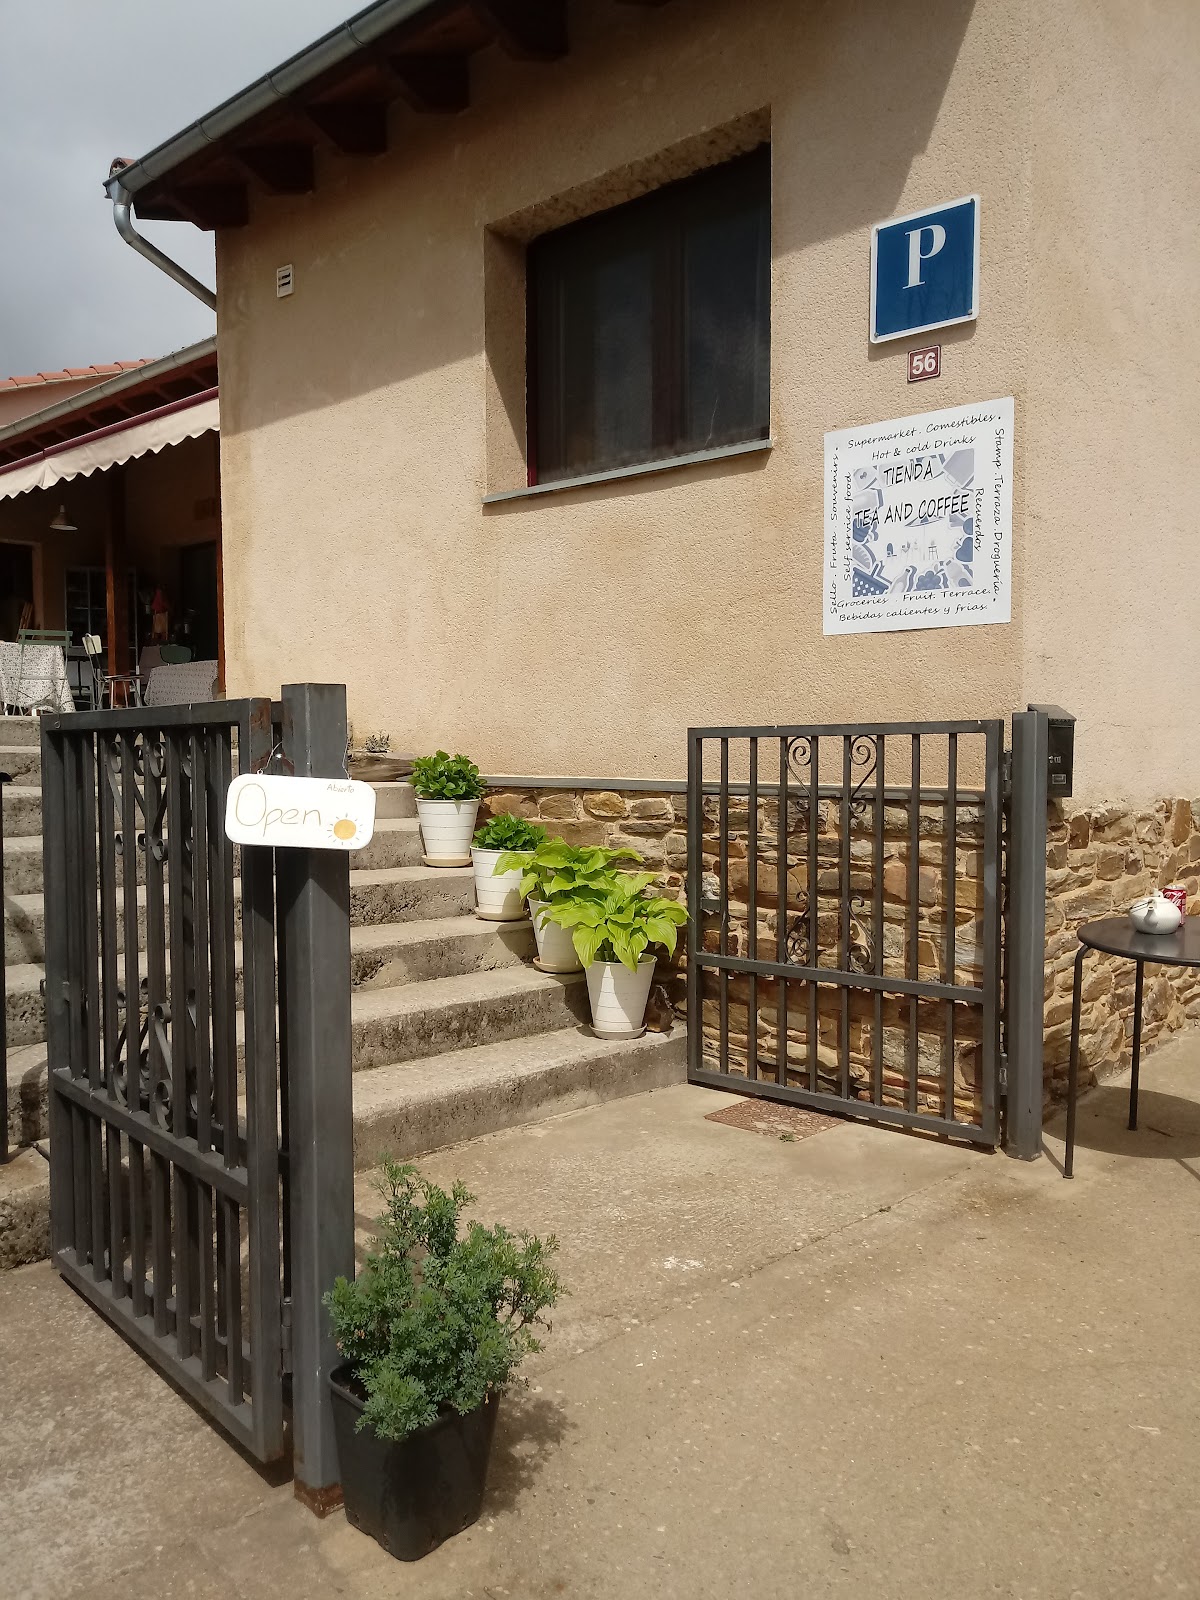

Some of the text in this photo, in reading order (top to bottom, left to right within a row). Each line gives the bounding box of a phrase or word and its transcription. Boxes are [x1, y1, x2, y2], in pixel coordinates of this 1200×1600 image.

[902, 224, 946, 289] P
[912, 351, 936, 375] 56
[871, 435, 977, 461] Hot & cold Drinks
[883, 460, 934, 485] TIENDA
[854, 493, 970, 528] TEA AND COFFEE
[974, 487, 985, 552] Recuerdos
[843, 471, 853, 581] Self service food
[839, 612, 884, 623] Bebidas
[886, 607, 940, 618] calientes
[943, 606, 951, 615] y
[326, 783, 355, 794] Abierto
[235, 783, 322, 838] Open
